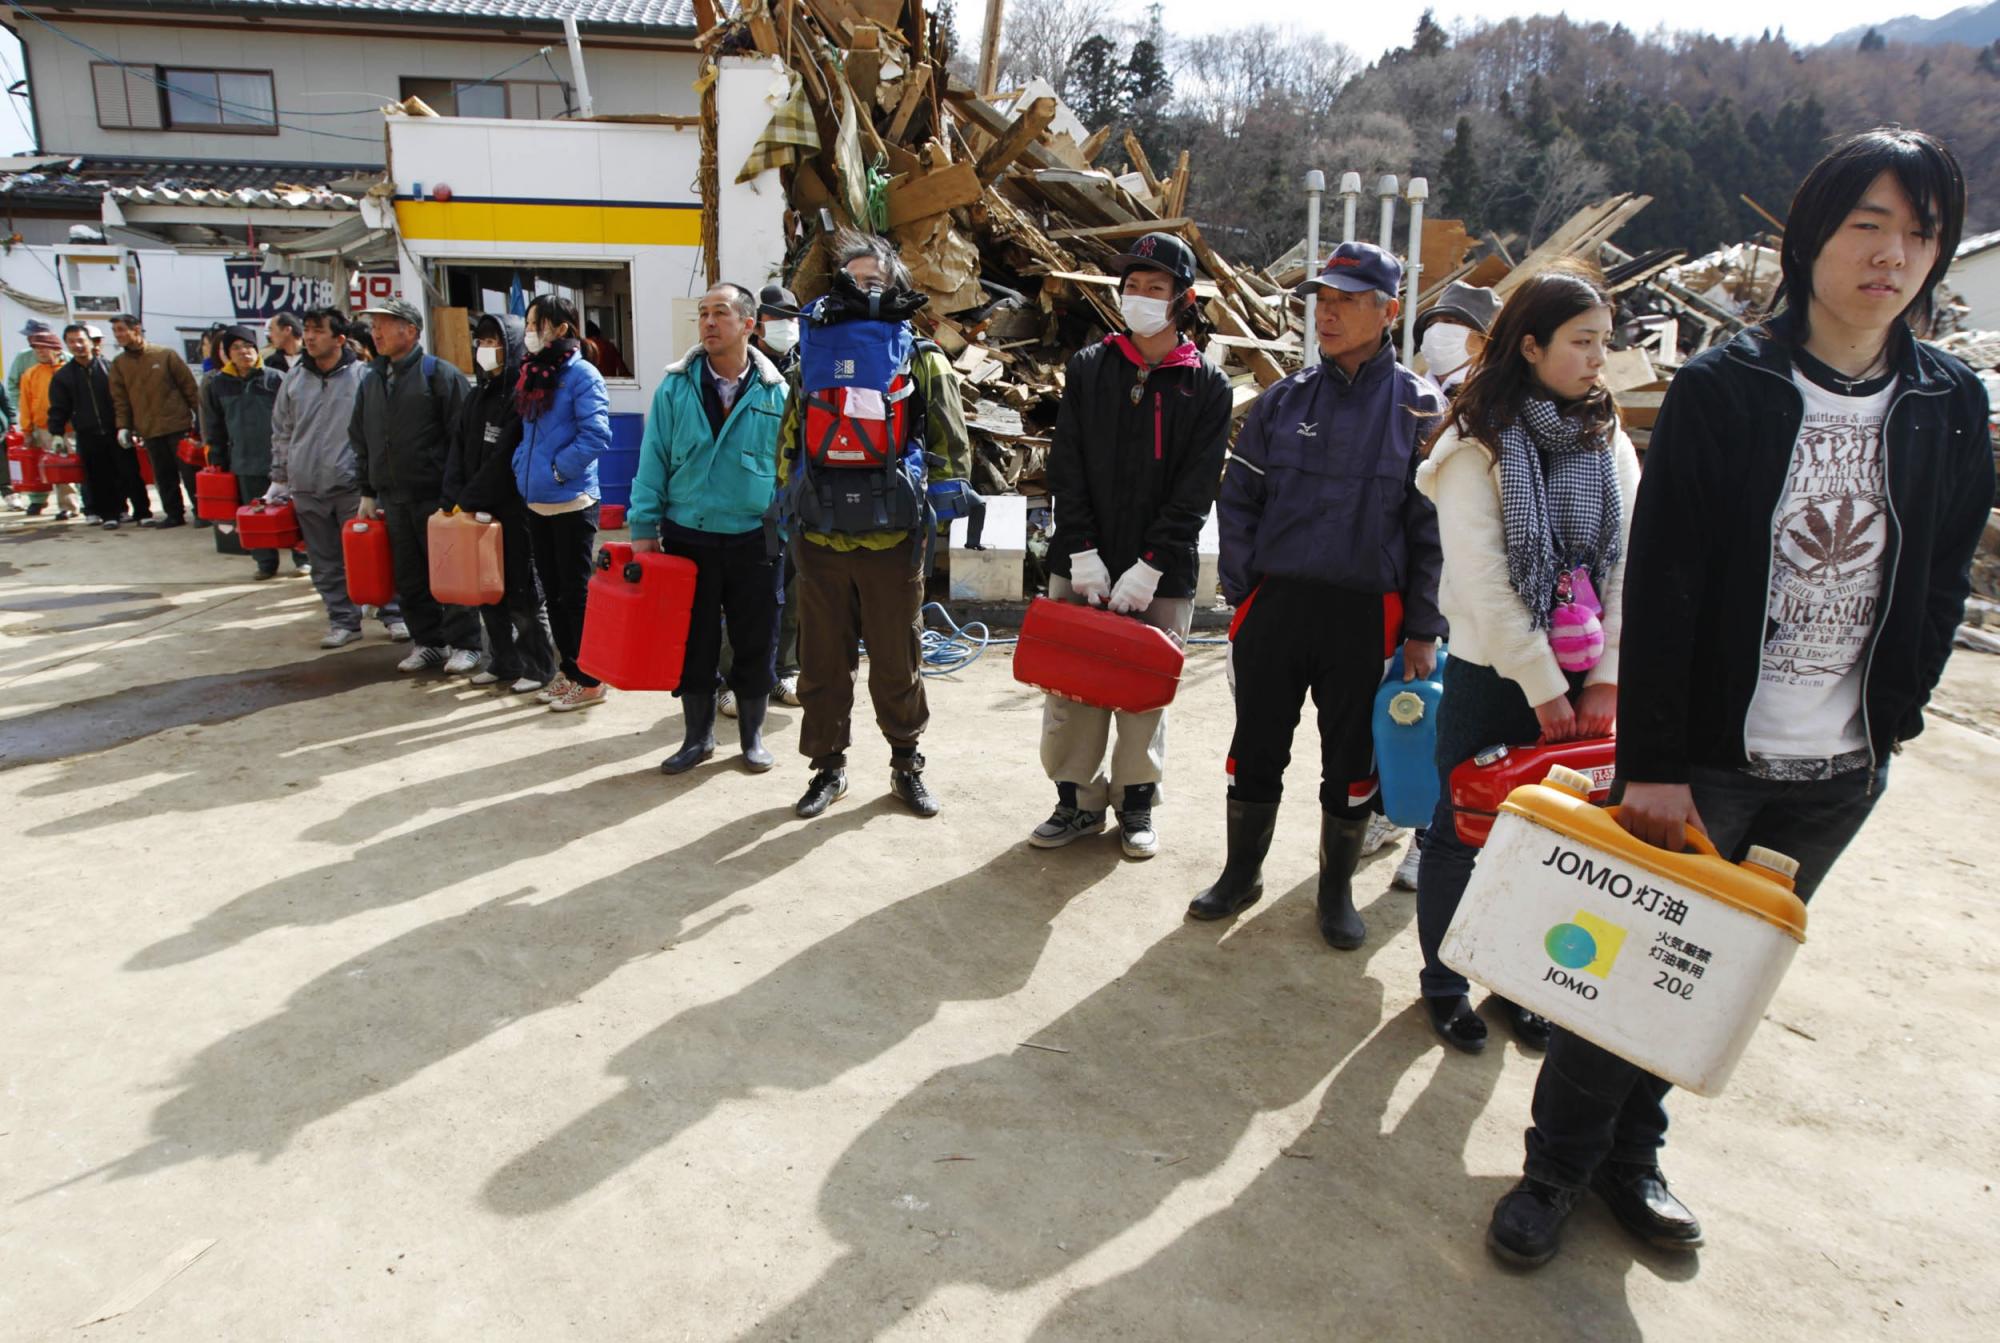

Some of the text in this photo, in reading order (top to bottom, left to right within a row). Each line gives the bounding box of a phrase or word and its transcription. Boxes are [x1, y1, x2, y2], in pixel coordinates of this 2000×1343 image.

[231, 273, 335, 311] セルフ灯油
[1777, 594, 1874, 625] NECESSAR
[1542, 846, 1689, 926] JOMO 灯油
[1542, 966, 1598, 1000] JOMO
